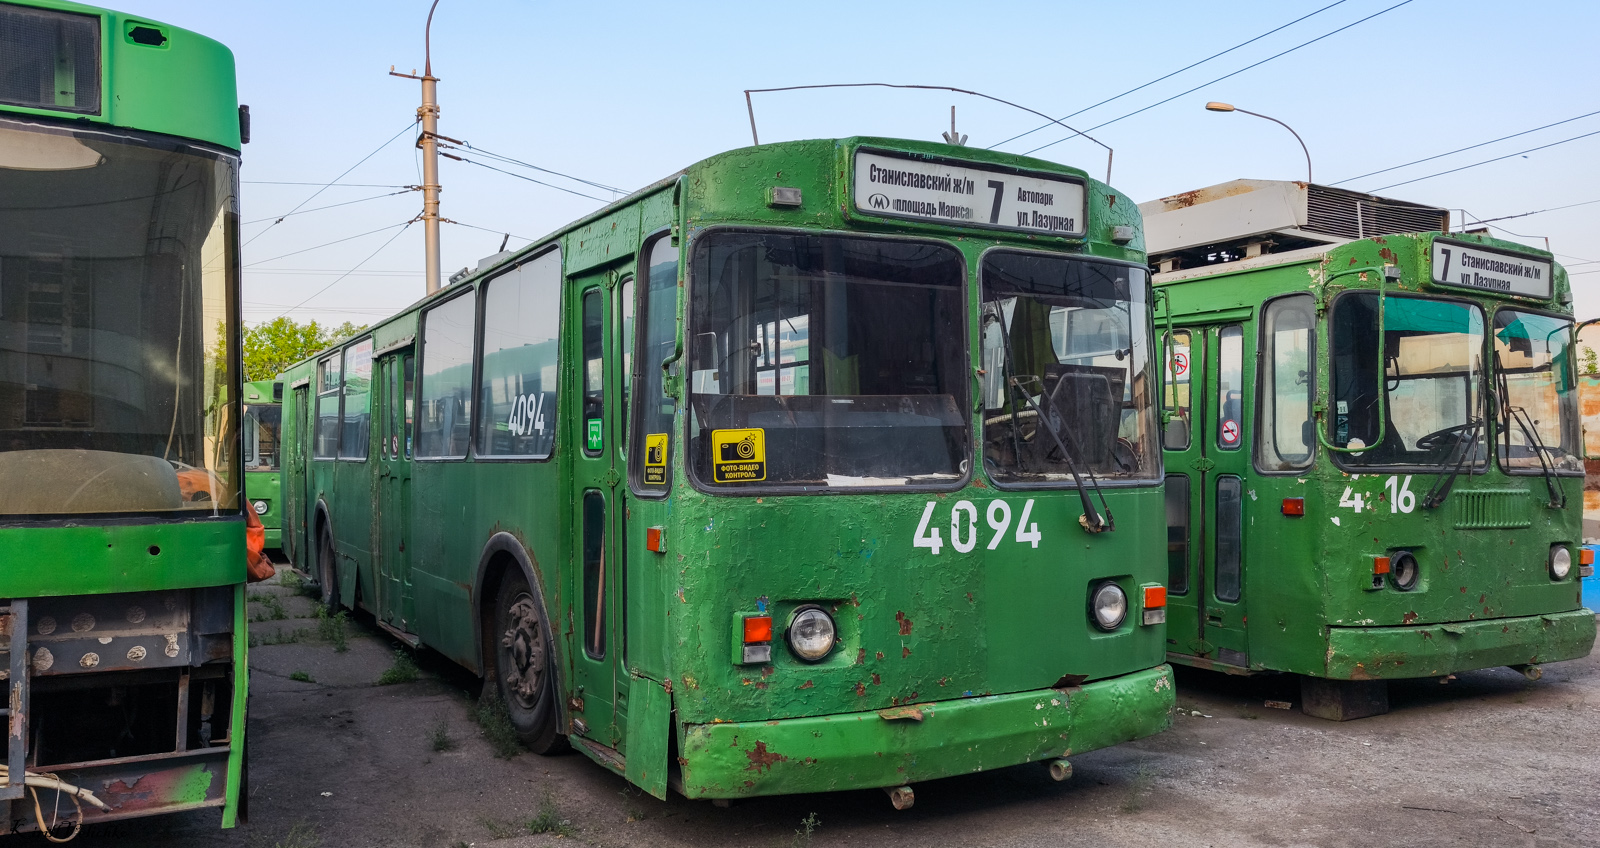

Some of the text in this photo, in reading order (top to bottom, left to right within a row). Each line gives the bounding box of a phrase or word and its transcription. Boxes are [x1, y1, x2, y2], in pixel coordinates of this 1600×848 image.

[869, 163, 975, 196] Станиславский ж/м
[987, 179, 1005, 225] 7
[1017, 187, 1054, 206] Автопарк
[1017, 211, 1074, 232] ул. Лазурная
[1441, 248, 1451, 281] 7
[1461, 252, 1541, 280] Станиславский ж/м
[1461, 272, 1472, 285] ул.
[508, 392, 545, 436] 4094
[720, 464, 760, 472] ФОТО-ВИДЕО
[725, 471, 757, 479] КОНТРОЛЬ
[1338, 474, 1416, 514] 416
[913, 498, 1042, 555] 4094
